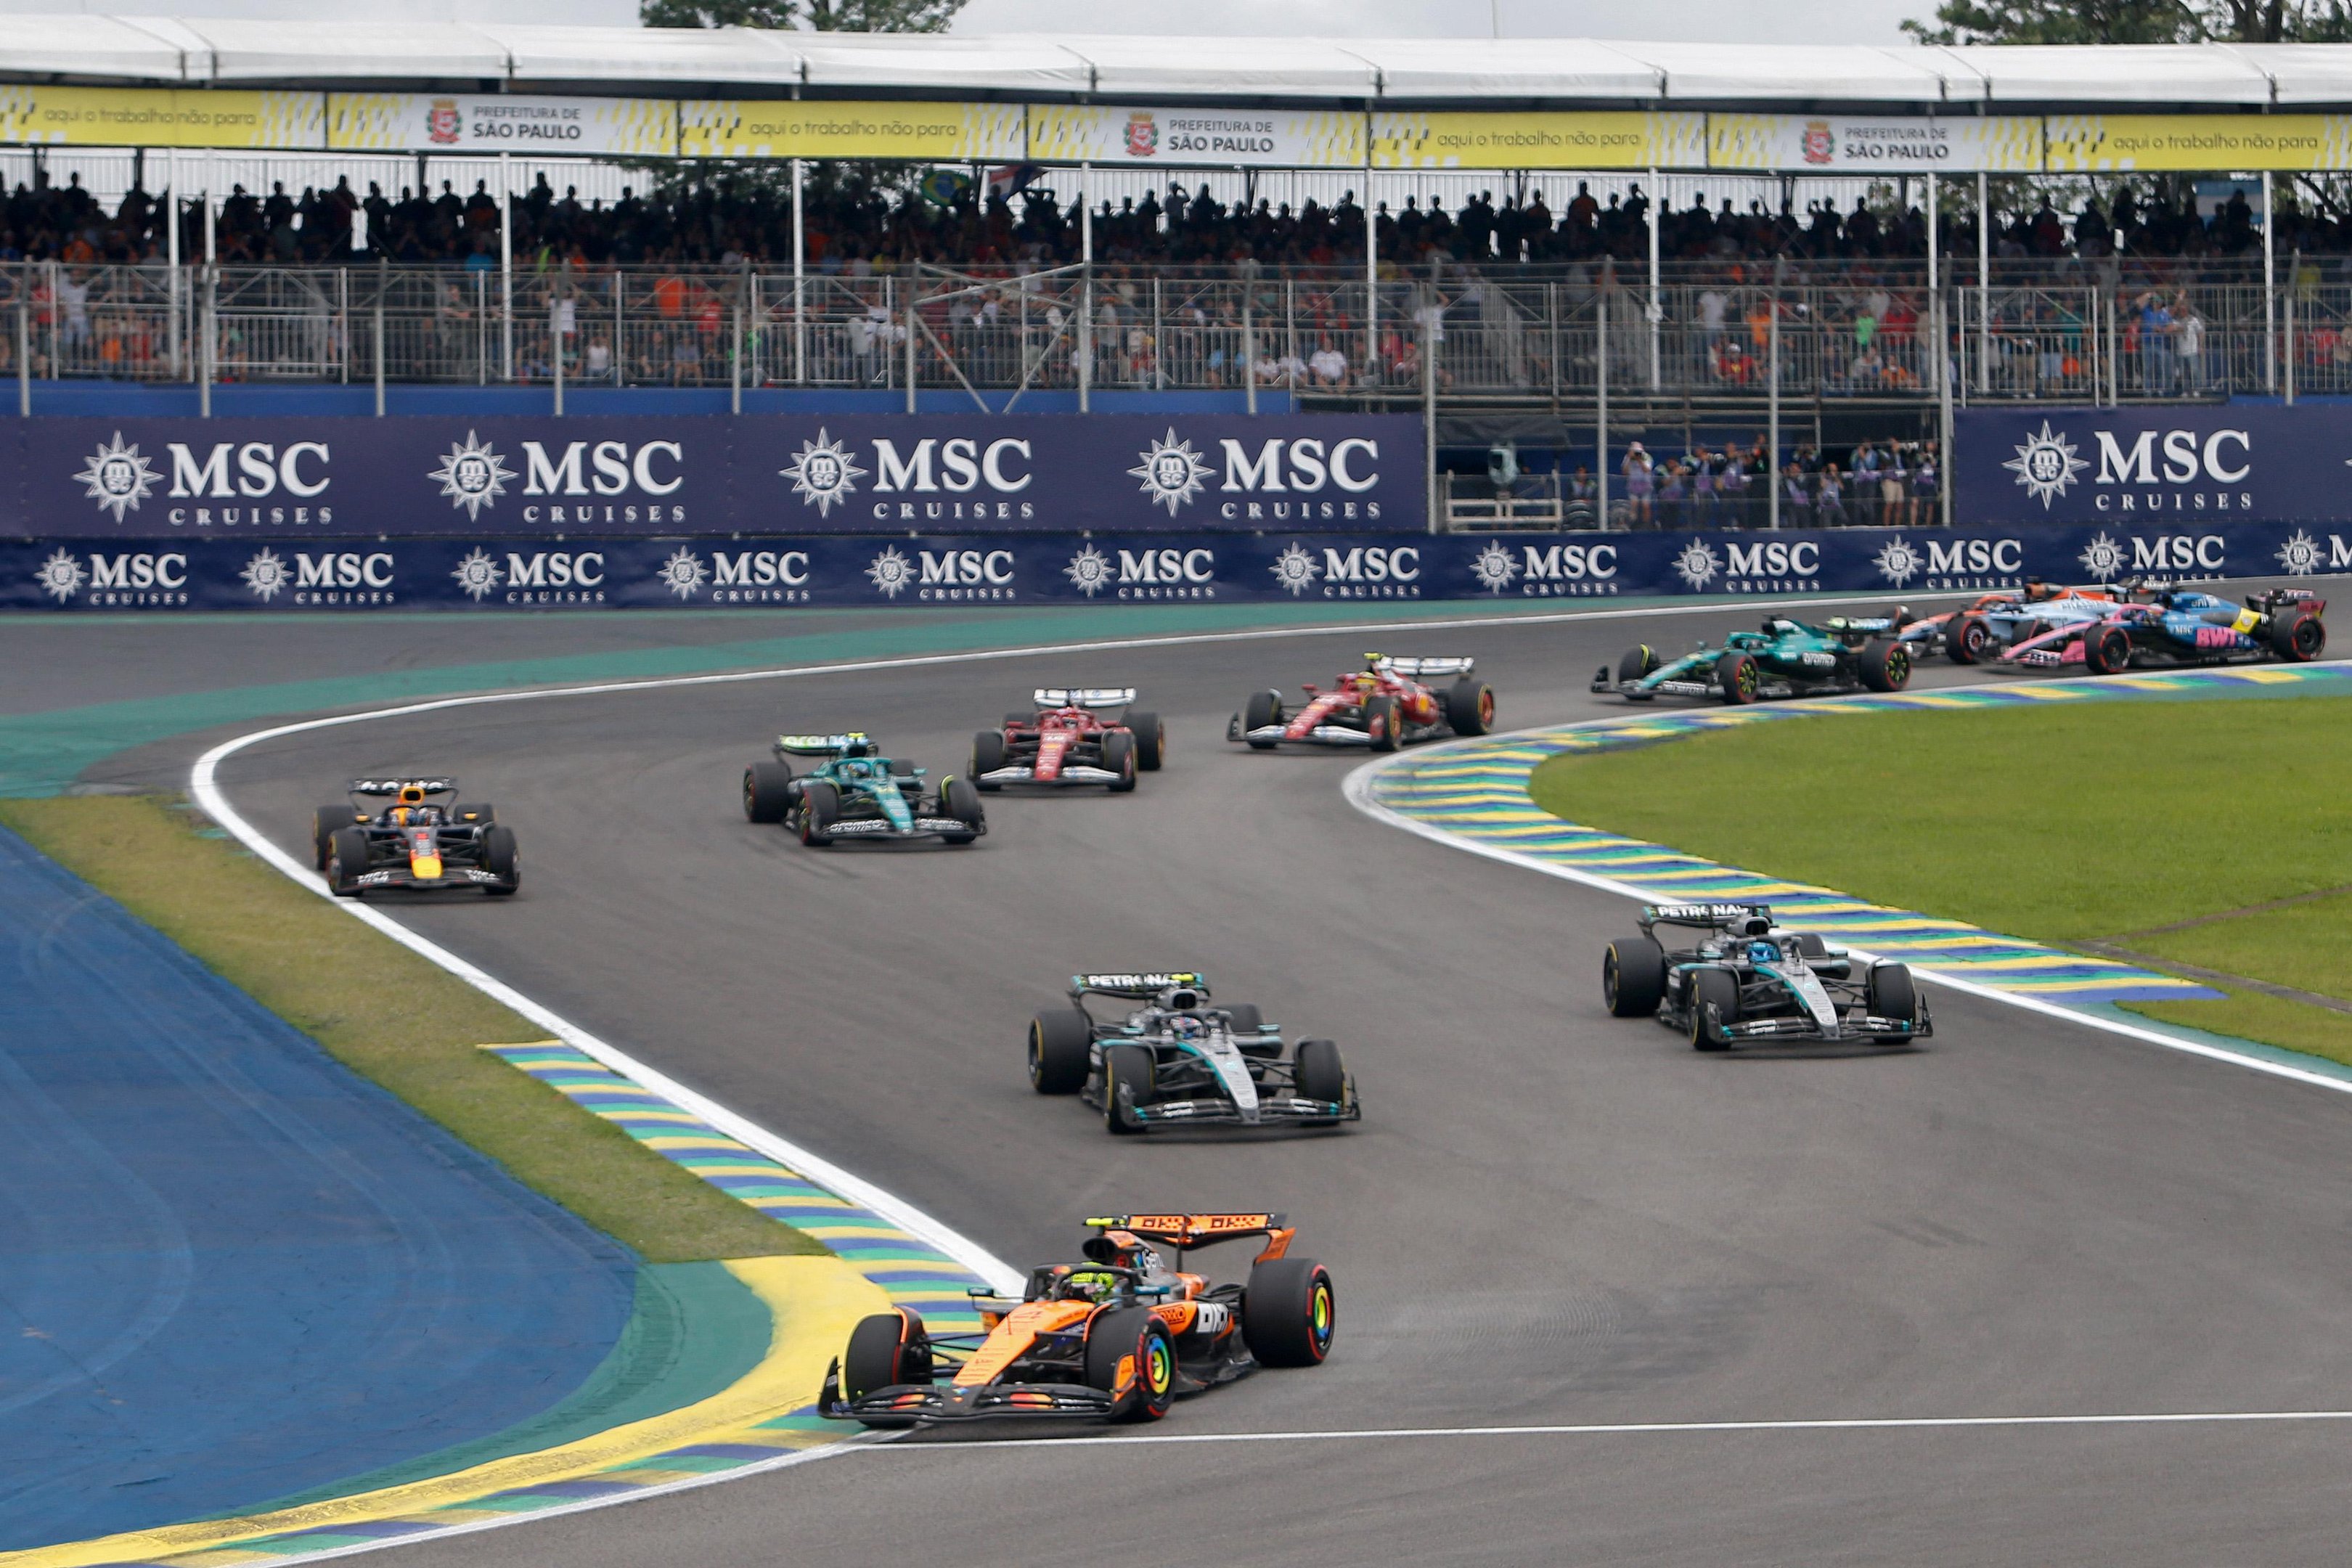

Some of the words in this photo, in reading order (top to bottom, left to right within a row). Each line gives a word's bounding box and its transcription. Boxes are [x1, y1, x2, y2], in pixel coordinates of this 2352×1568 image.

[44, 107, 78, 126] aqui
[85, 112, 96, 123] o
[100, 106, 174, 123] trabalho
[176, 108, 211, 124] não
[215, 113, 256, 128] para
[474, 106, 559, 119] PREFEITURA
[563, 107, 580, 119] DE
[474, 120, 512, 138] SÃO
[518, 123, 581, 139] PAULO
[750, 120, 785, 138] aqui
[790, 123, 801, 135] o
[805, 119, 876, 135] trabalho
[881, 121, 912, 135] não
[917, 123, 957, 140] para
[1169, 119, 1251, 132] PREFEITURA
[1255, 121, 1273, 133] DE
[1845, 128, 1927, 139] PREFEITURA
[1930, 128, 1948, 139] DE
[1168, 133, 1208, 151] SÃO
[1212, 136, 1274, 152] PAULO
[1437, 131, 1471, 149] aqui
[1476, 134, 1487, 146] o
[1490, 130, 1561, 146] trabalho
[1565, 131, 1596, 146] não
[1600, 134, 1639, 149] para
[2113, 134, 2149, 153] aqui
[2152, 136, 2163, 150] o
[2167, 133, 2239, 150] trabalho
[2242, 134, 2274, 150] não
[2278, 136, 2318, 153] para
[1845, 140, 1883, 158] SÃO
[1888, 144, 1949, 159] PAULO
[871, 438, 1032, 492] MSC
[1219, 438, 1379, 492] MSC
[2094, 429, 2250, 483] MSC
[166, 441, 330, 498] MSC
[521, 440, 682, 496] MSC
[873, 502, 1034, 519] CRUISES
[1221, 502, 1380, 519] CRUISES
[2095, 493, 2251, 510] CRUISES
[168, 507, 332, 526] CRUISES
[523, 505, 685, 523] CRUISES
[1523, 544, 1617, 579] MSC
[1726, 542, 1819, 576] MSC
[1926, 539, 2022, 574] MSC
[2131, 535, 2224, 570] MSC
[90, 553, 187, 589] MSC
[295, 552, 393, 587] MSC
[507, 552, 603, 587] MSC
[712, 551, 808, 586] MSC
[918, 550, 1014, 584] MSC
[1117, 549, 1213, 583] MSC
[1323, 547, 1419, 581] MSC
[1118, 587, 1215, 598] CRUISES
[1323, 585, 1420, 597] CRUISES
[1523, 582, 1618, 595] CRUISES
[1726, 580, 1820, 592] CRUISES
[1927, 577, 2022, 590] CRUISES
[89, 592, 187, 605] CRUISES
[294, 592, 394, 604] CRUISES
[507, 591, 605, 603] CRUISES
[712, 589, 809, 603] CRUISES
[919, 588, 1016, 600] CRUISES
[2196, 627, 2237, 648] BWT
